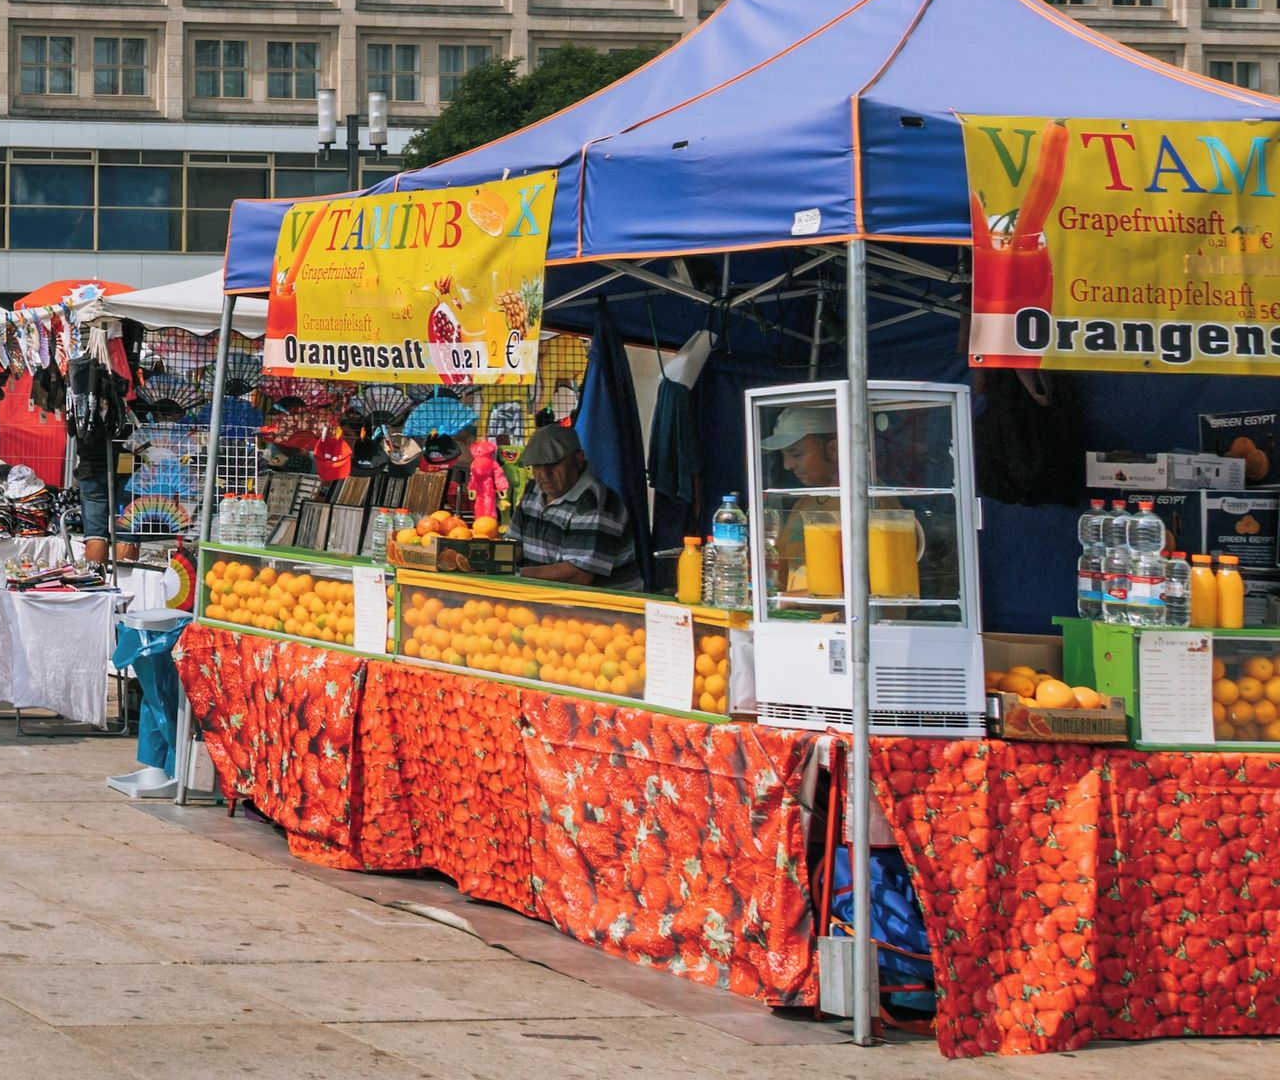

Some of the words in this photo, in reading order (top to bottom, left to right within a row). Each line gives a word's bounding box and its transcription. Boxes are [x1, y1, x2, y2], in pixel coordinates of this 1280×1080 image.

[1058, 206, 1226, 239] Grapefruitsaft
[301, 262, 365, 284] Grapefruitsaft
[1071, 278, 1255, 311] Granatapfelsaft
[303, 313, 372, 335] Granatapfelsaft
[285, 336, 425, 373] Orangensaft
[506, 331, 520, 368] €
[1210, 417, 1241, 428] GREEN
[1244, 414, 1276, 426] EGYPT
[1157, 495, 1187, 505] EGYPT
[1218, 535, 1247, 543] GREEN
